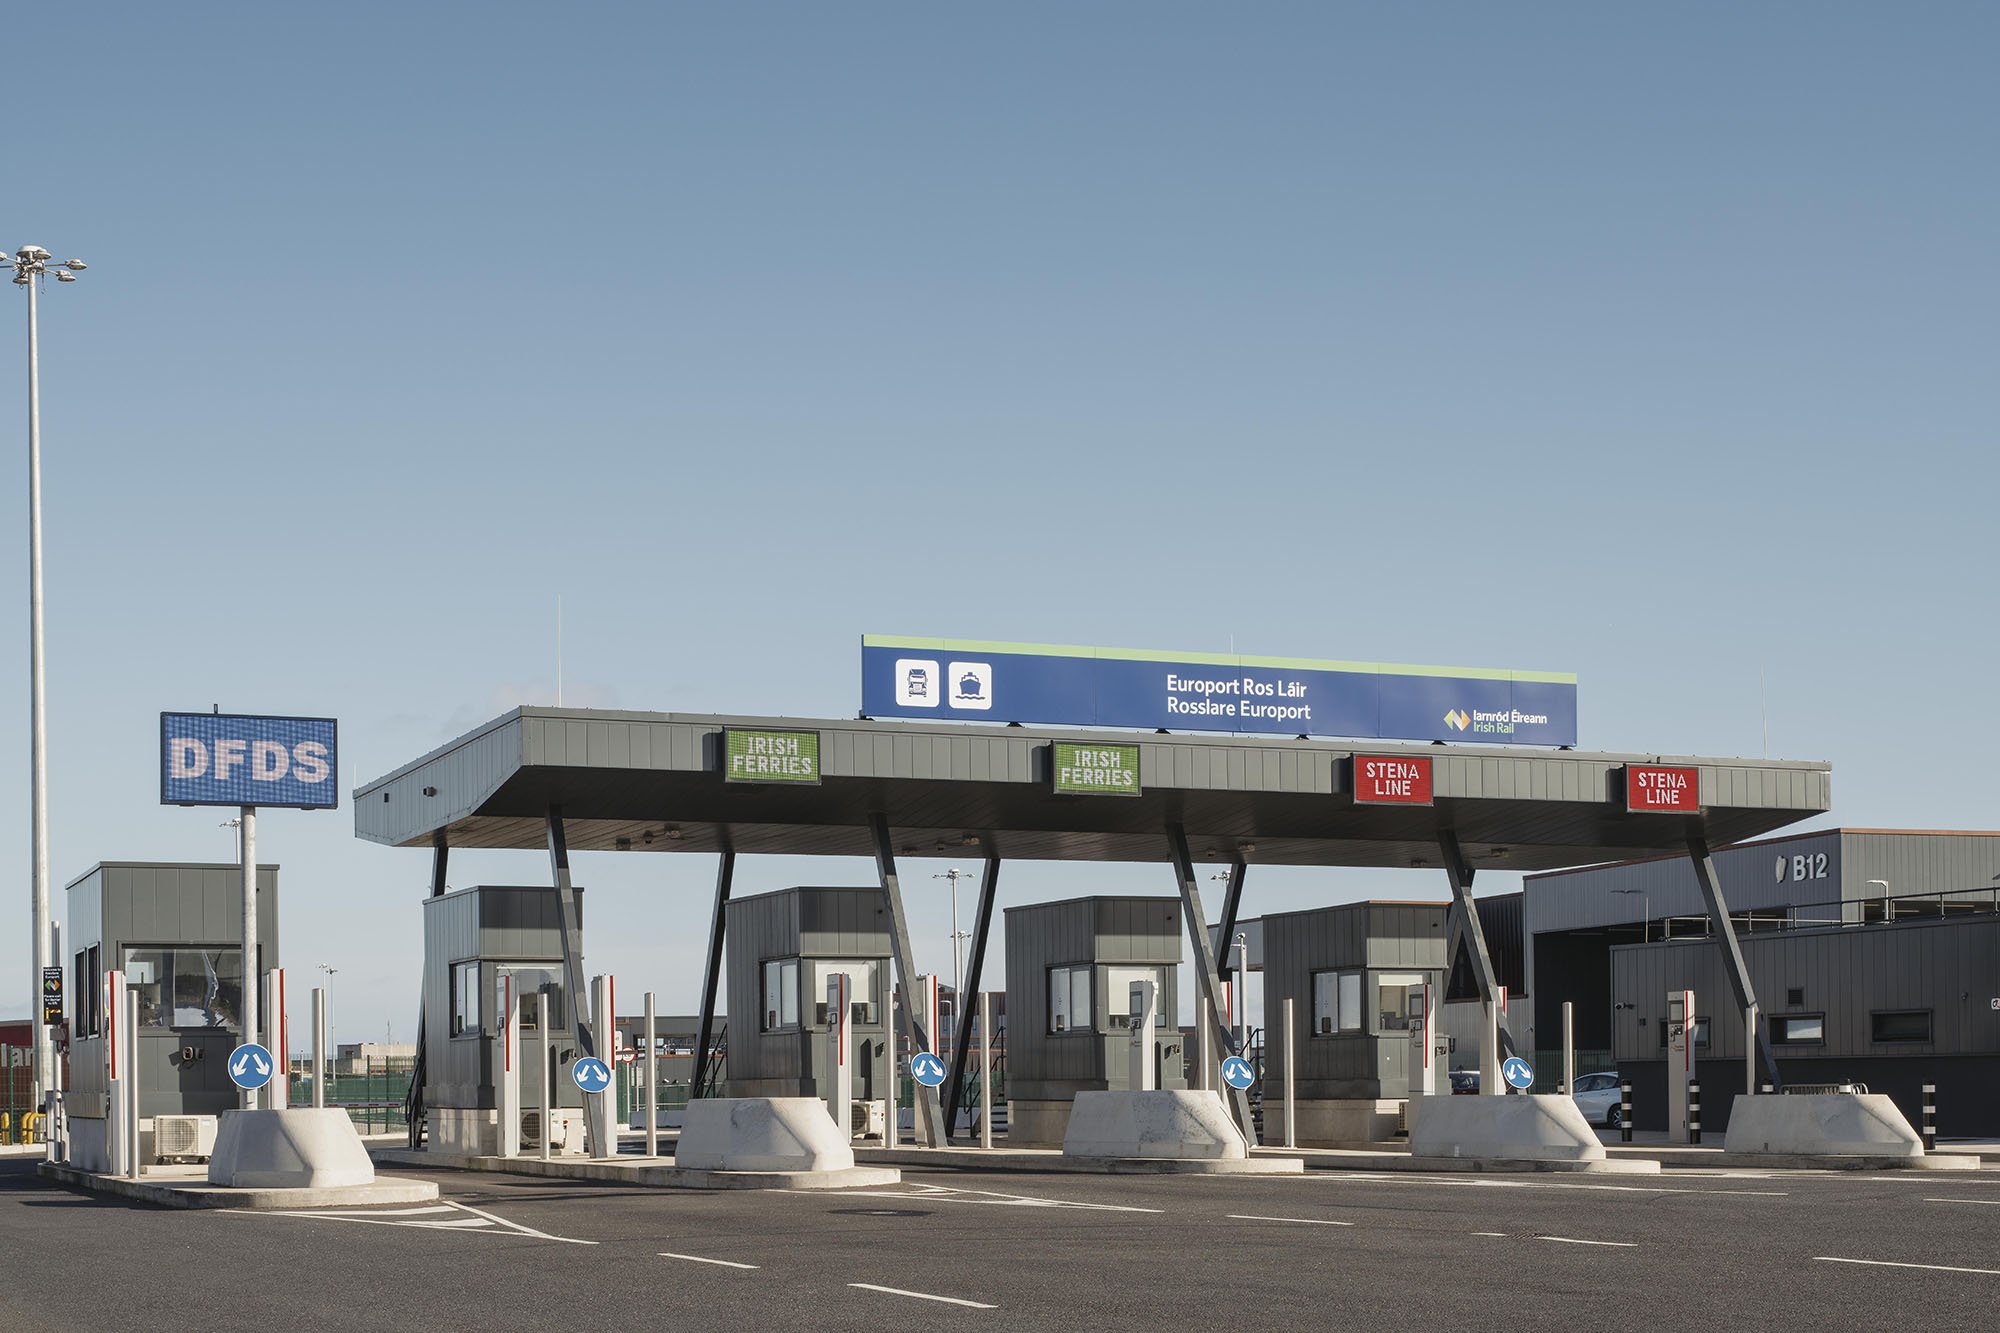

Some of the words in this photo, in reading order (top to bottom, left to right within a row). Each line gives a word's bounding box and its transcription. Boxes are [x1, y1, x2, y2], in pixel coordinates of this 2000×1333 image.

[1167, 674, 1240, 697] Europort
[1243, 678, 1274, 696] Ros
[1278, 680, 1307, 698] Láir
[1167, 696, 1236, 716] Rosslare
[1240, 700, 1311, 722] Europort
[1473, 709, 1509, 722] Iarnród
[1511, 709, 1548, 725] Éireann
[1473, 722, 1495, 733] Irish
[1497, 723, 1515, 734] Rail
[748, 736, 798, 756] IRISH
[170, 737, 329, 783] DFDS
[733, 754, 811, 775] FERRIES
[1074, 750, 1120, 768] IRISH
[1061, 767, 1133, 785] FERRIES
[1366, 762, 1419, 779] STENA
[1375, 779, 1411, 796] LINE
[1638, 772, 1687, 788] STENA
[1646, 788, 1680, 804] LINE
[1793, 853, 1828, 881] B12
